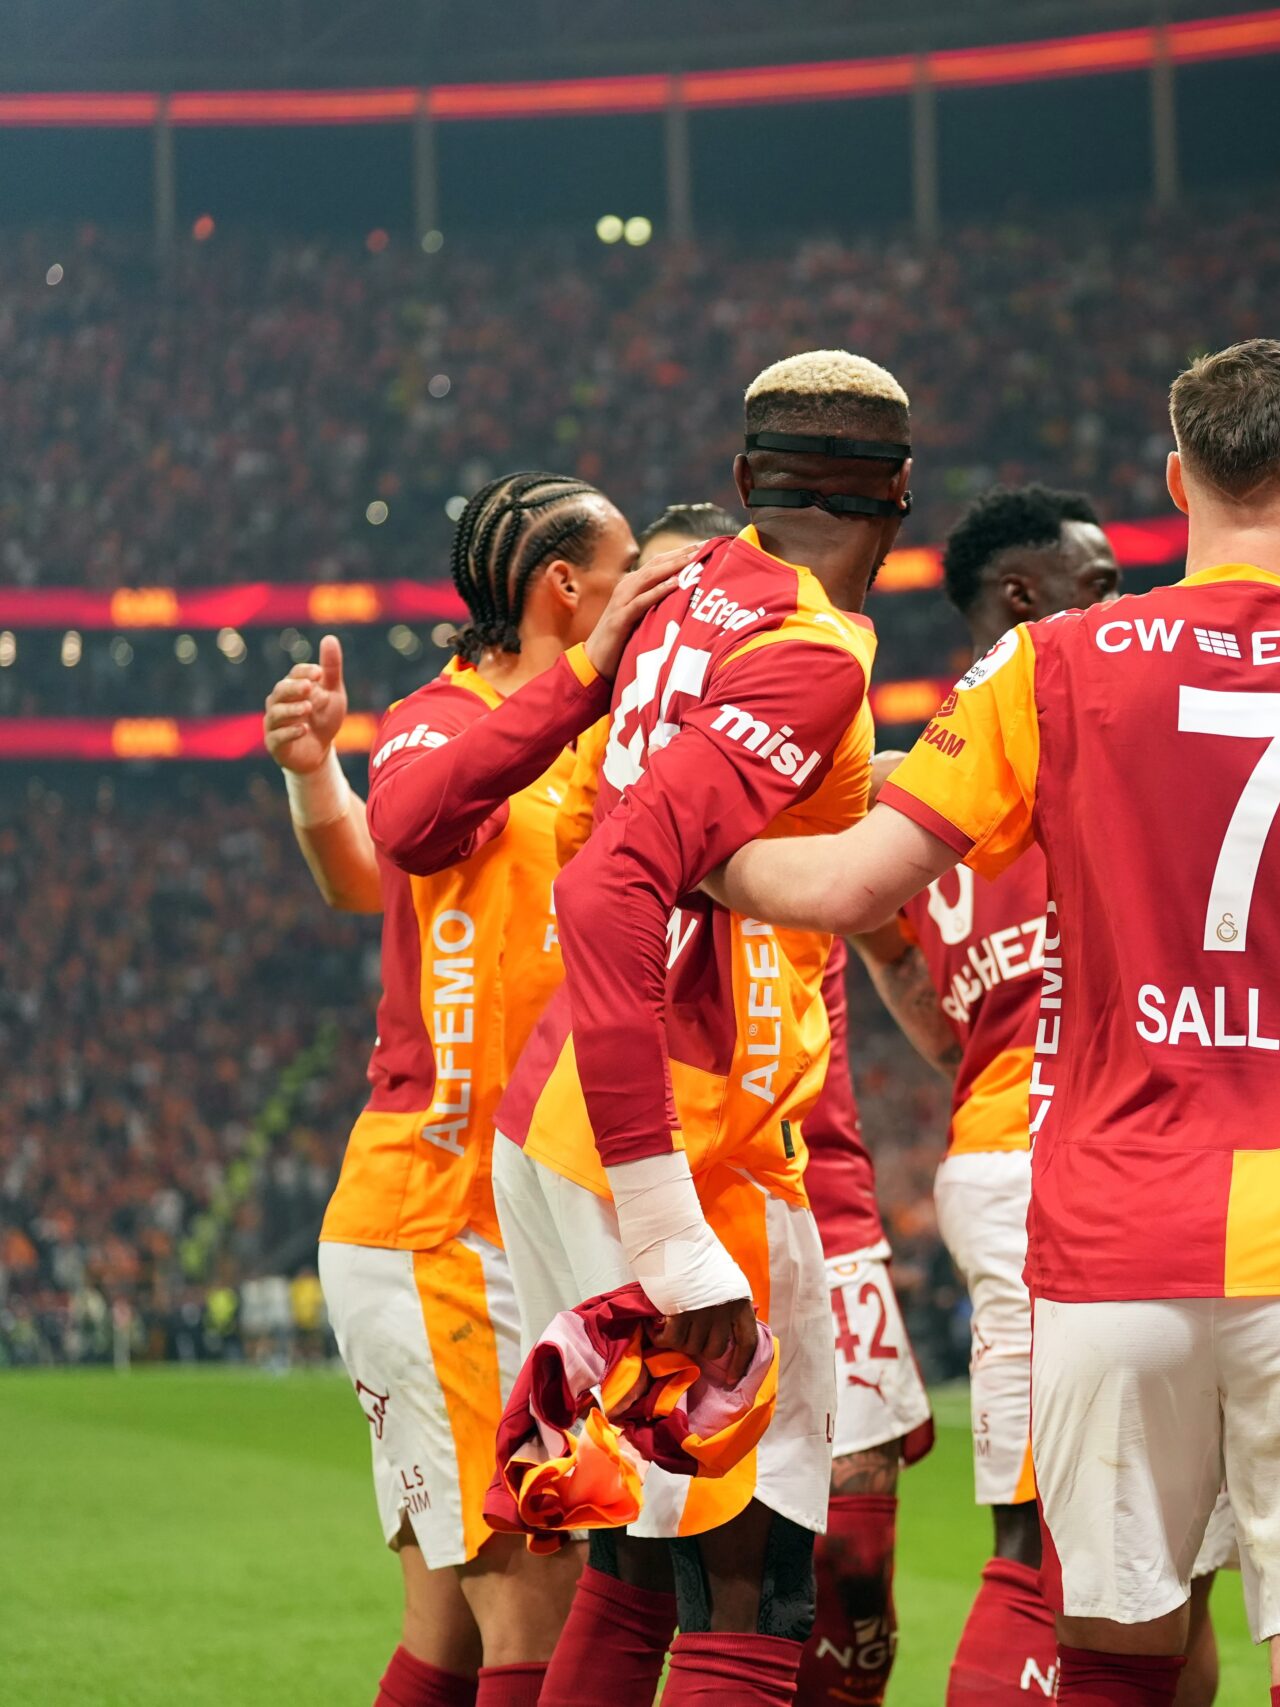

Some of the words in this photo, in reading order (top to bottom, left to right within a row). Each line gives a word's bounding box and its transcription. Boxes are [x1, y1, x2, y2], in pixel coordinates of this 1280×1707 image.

[1095, 618, 1185, 653] CW
[421, 908, 475, 1158] ALFEMO
[740, 917, 782, 1105] ALFE
[830, 1281, 899, 1364] 42
